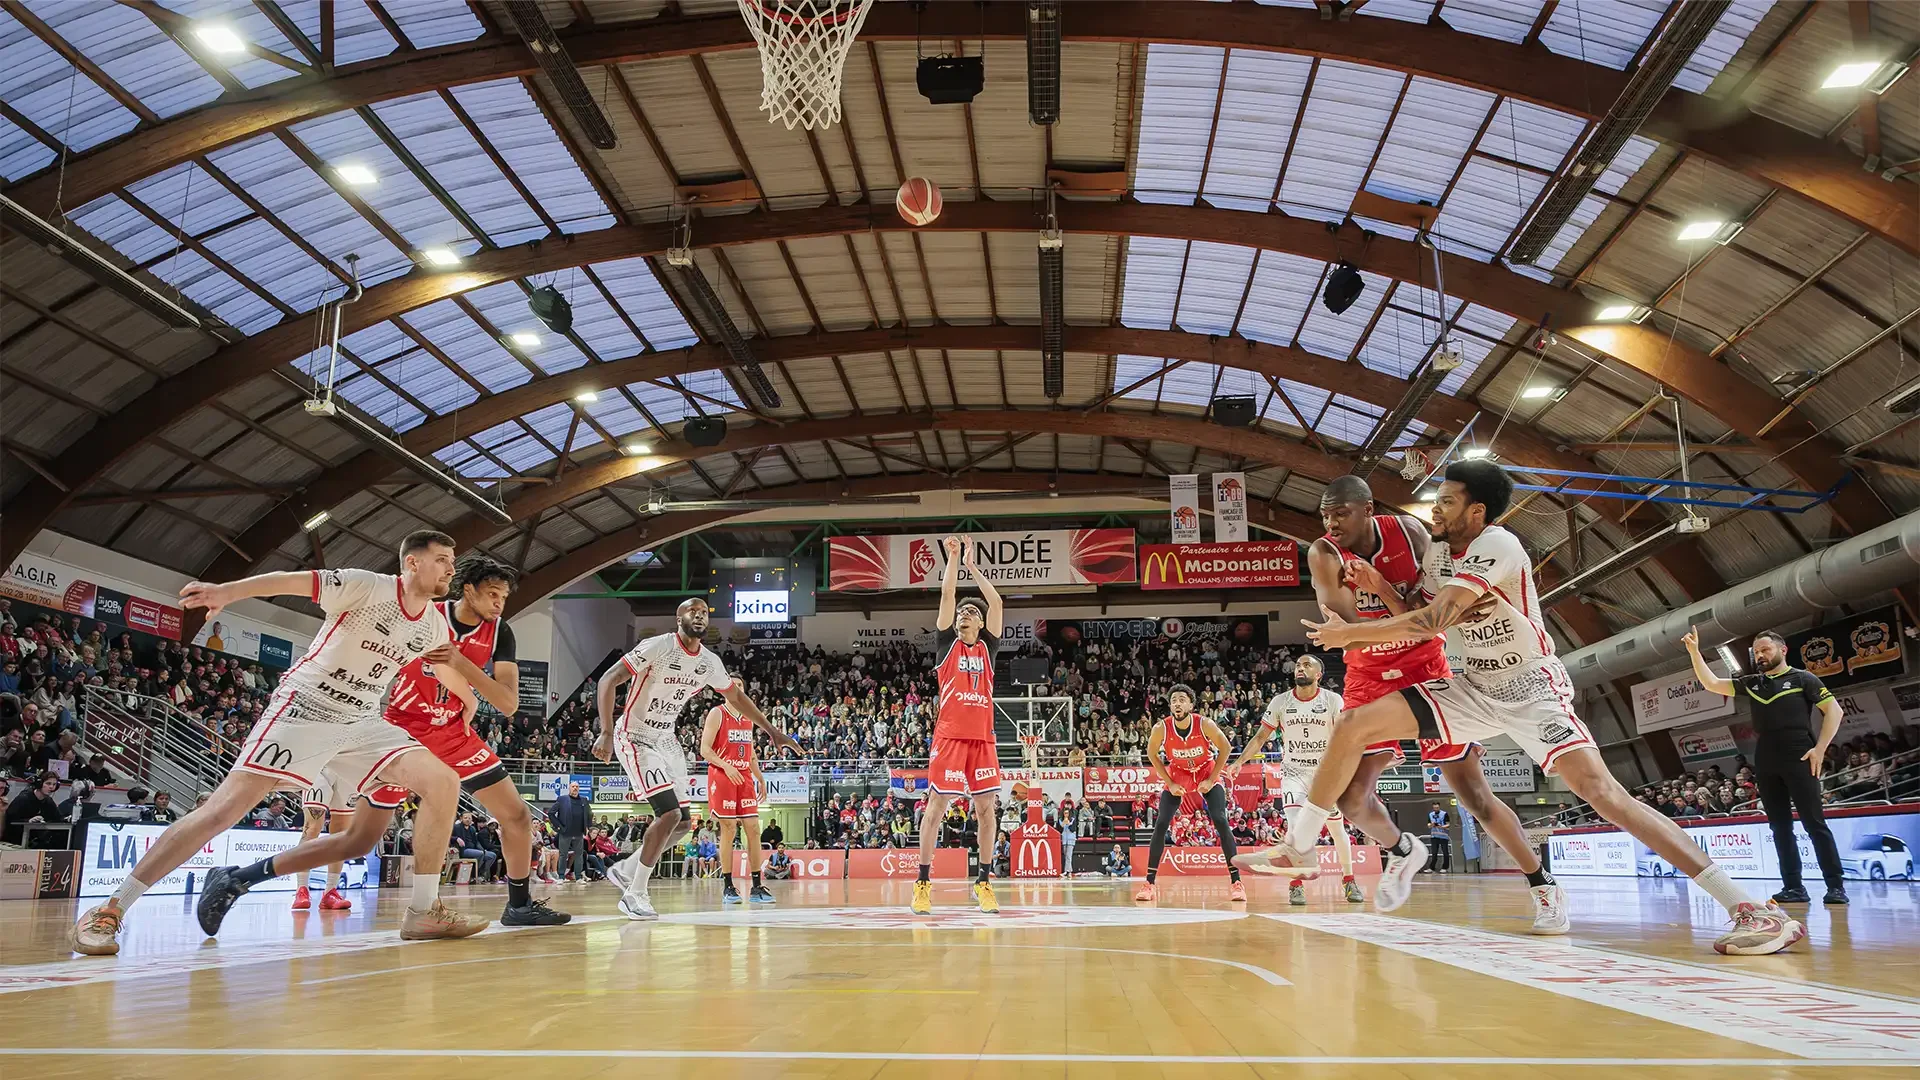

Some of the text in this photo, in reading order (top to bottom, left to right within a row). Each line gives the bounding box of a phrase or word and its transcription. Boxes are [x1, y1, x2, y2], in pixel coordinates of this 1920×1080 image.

[1180, 543, 1292, 555] Partenaire de votre club
[1185, 557, 1294, 573] McDonald's
[754, 573, 761, 583] 8
[736, 600, 787, 614] ixina
[857, 628, 906, 637] VILLE DE
[1083, 620, 1157, 639] HYPER
[360, 640, 409, 667] CHALLA
[368, 662, 388, 679] 93
[971, 674, 978, 691] 7
[673, 688, 686, 701] 35
[1666, 684, 1686, 700] Crédit
[1286, 717, 1327, 727] CHALLANS
[1303, 727, 1309, 738] 5
[738, 745, 745, 758] 9
[976, 768, 995, 779] SMT
[1106, 768, 1151, 784] KOP
[1085, 783, 1127, 793] CRAZY
[1378, 783, 1403, 791] SORTIE
[600, 793, 622, 801] SORTIE
[235, 842, 269, 852] DÉCOUVREZ
[1709, 834, 1752, 847] LITTORAL
[1162, 848, 1227, 868] Adresse
[40, 856, 52, 892] ATELIER
[50, 864, 71, 892] 24
[1014, 869, 1058, 877] CHALLANS
